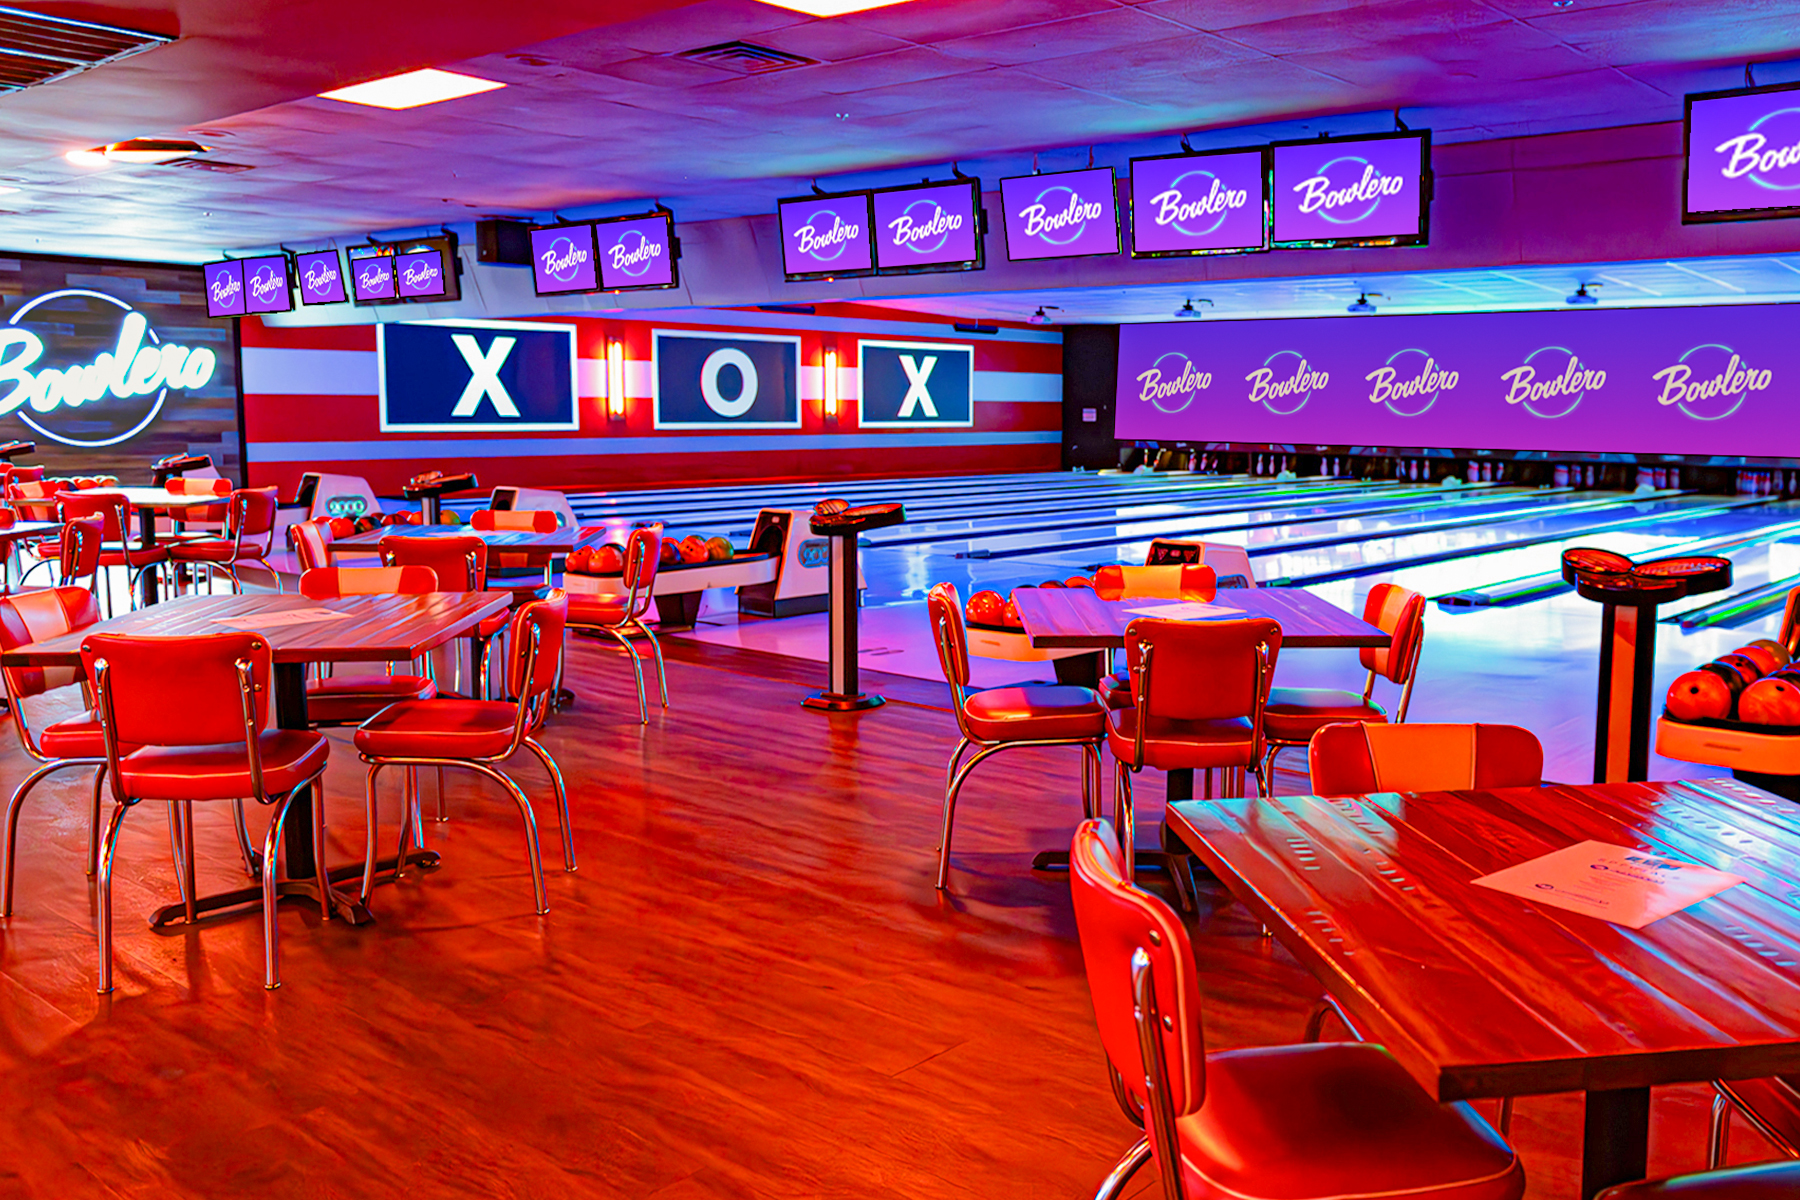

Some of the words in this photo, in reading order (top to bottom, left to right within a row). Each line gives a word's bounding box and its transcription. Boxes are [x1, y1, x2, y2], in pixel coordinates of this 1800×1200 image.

[1149, 178, 1247, 226] Bowlero
[1293, 164, 1404, 214] Bowlero
[793, 215, 860, 253] Bowlero
[888, 205, 963, 246] Bowlero
[1018, 192, 1102, 236] Bowlero
[540, 242, 588, 275] Bowlero
[607, 235, 662, 270] Bowlero
[0, 311, 217, 417] Bowlero
[450, 333, 521, 417] X
[701, 348, 758, 418] O
[897, 355, 940, 418] X
[1136, 360, 1212, 401] Bowlero
[1245, 359, 1329, 402] Bowlero
[1365, 357, 1459, 403] Bowlero
[1500, 356, 1607, 404] Bowlero
[1652, 354, 1772, 405] Bowlero
